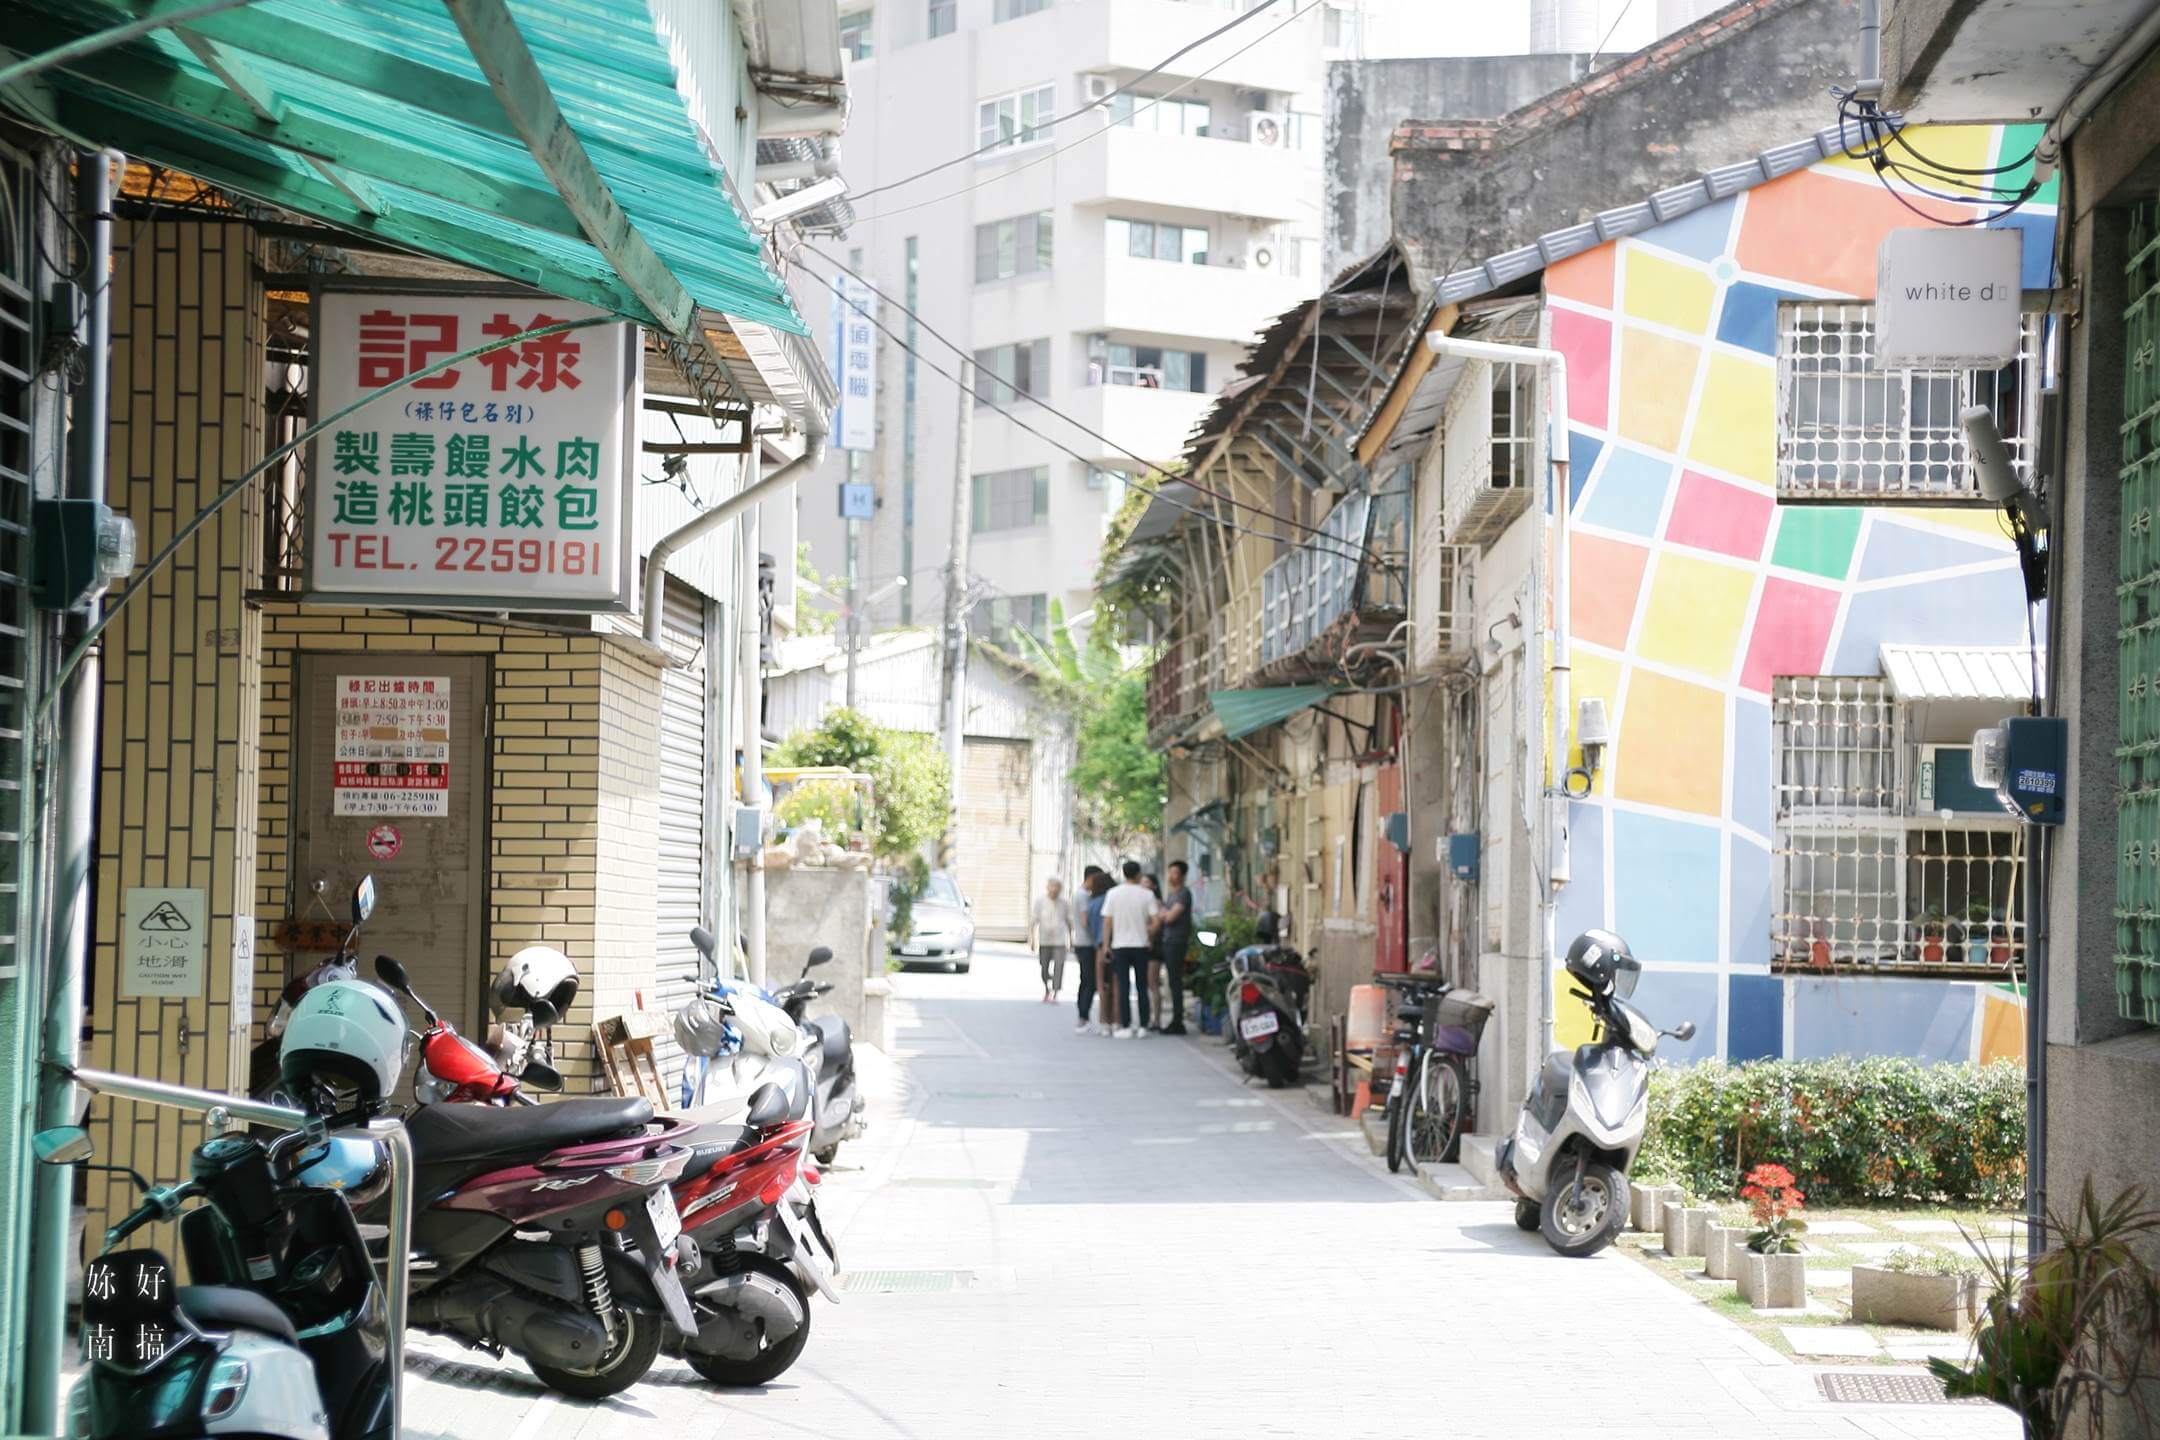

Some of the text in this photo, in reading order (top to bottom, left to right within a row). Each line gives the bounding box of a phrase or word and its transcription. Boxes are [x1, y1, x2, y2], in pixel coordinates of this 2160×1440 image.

[1905, 282, 1971, 301] white
[328, 533, 600, 576] TEL. 2259181
[138, 935, 189, 949] 小心
[136, 955, 189, 969] 地滑
[696, 1145, 727, 1156] SUZUKI
